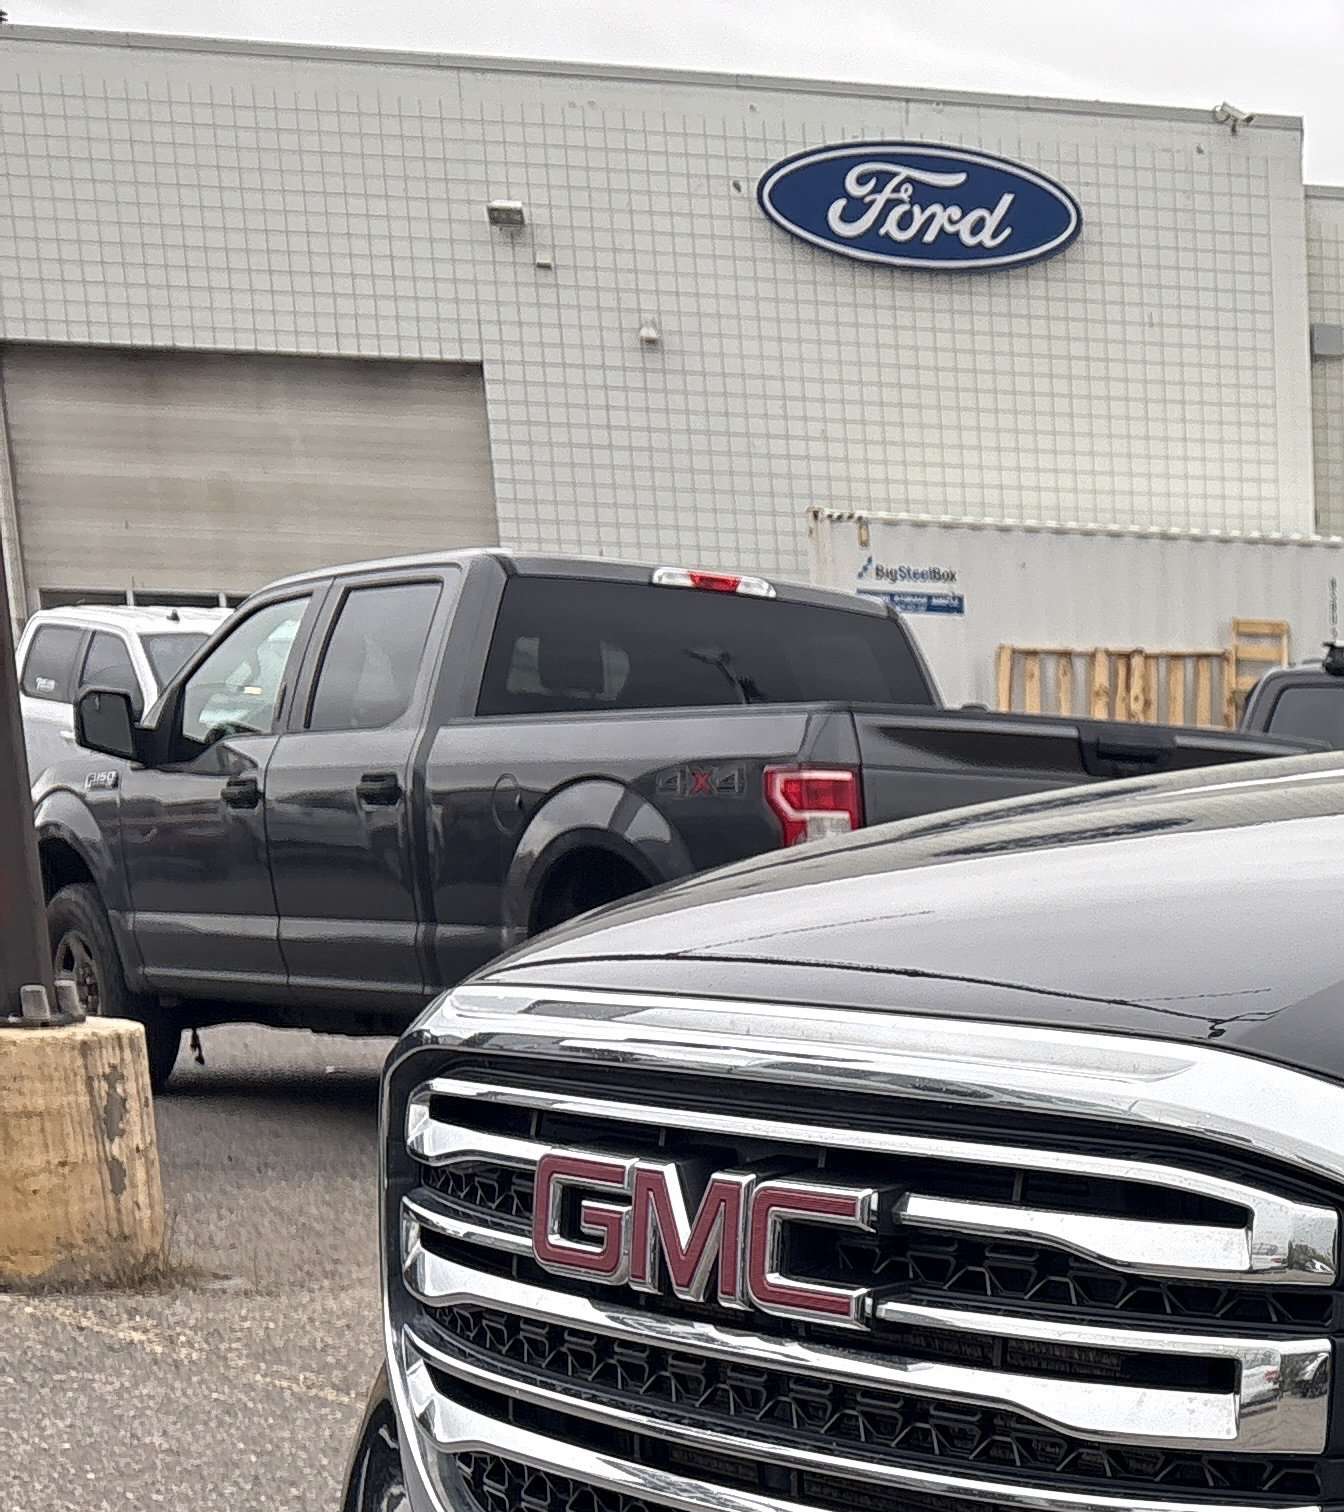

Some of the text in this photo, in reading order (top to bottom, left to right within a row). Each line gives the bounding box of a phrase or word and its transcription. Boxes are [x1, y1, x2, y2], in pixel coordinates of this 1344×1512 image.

[826, 161, 1014, 250] Ford
[875, 564, 957, 584] BigSteelBox
[532, 1149, 877, 1332] GMC
